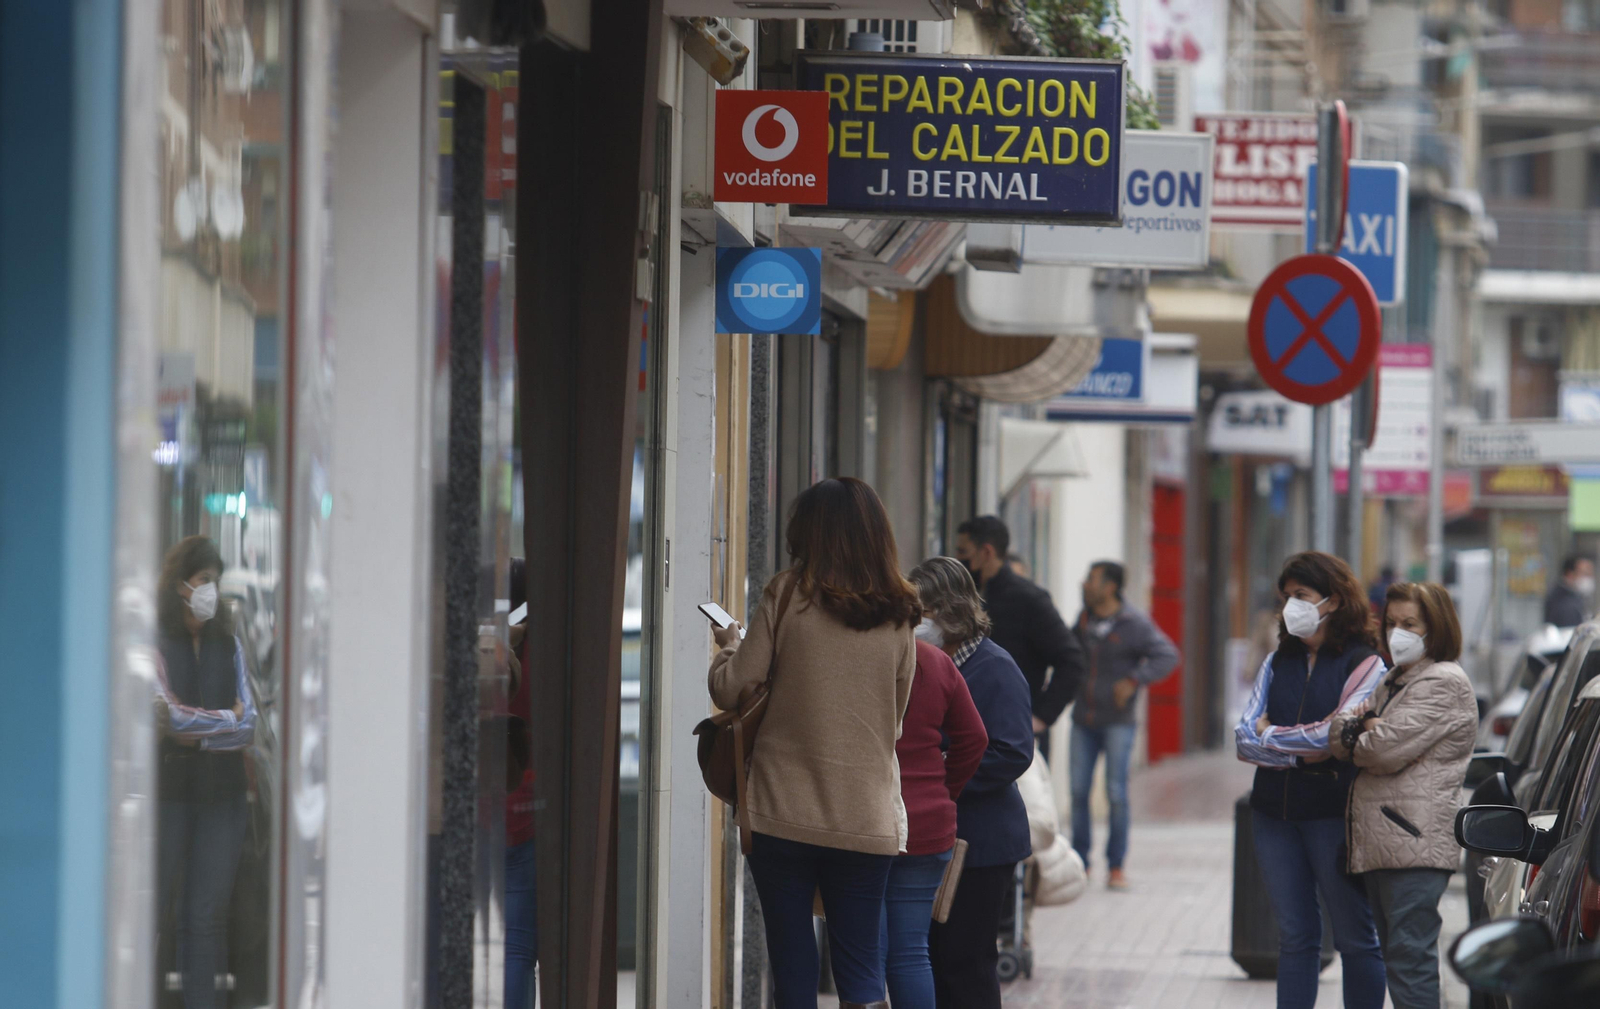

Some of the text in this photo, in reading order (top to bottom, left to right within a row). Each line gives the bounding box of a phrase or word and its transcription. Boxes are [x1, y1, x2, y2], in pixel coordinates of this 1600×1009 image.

[824, 72, 1097, 119] REPARACION
[912, 122, 1110, 167] CALZADO
[723, 168, 817, 187] vodafone
[866, 168, 1048, 201] J. BERNAL
[1122, 169, 1202, 208] GON
[1122, 213, 1203, 234] eportivos
[1309, 209, 1395, 258] AXI
[733, 283, 804, 299] DIGI
